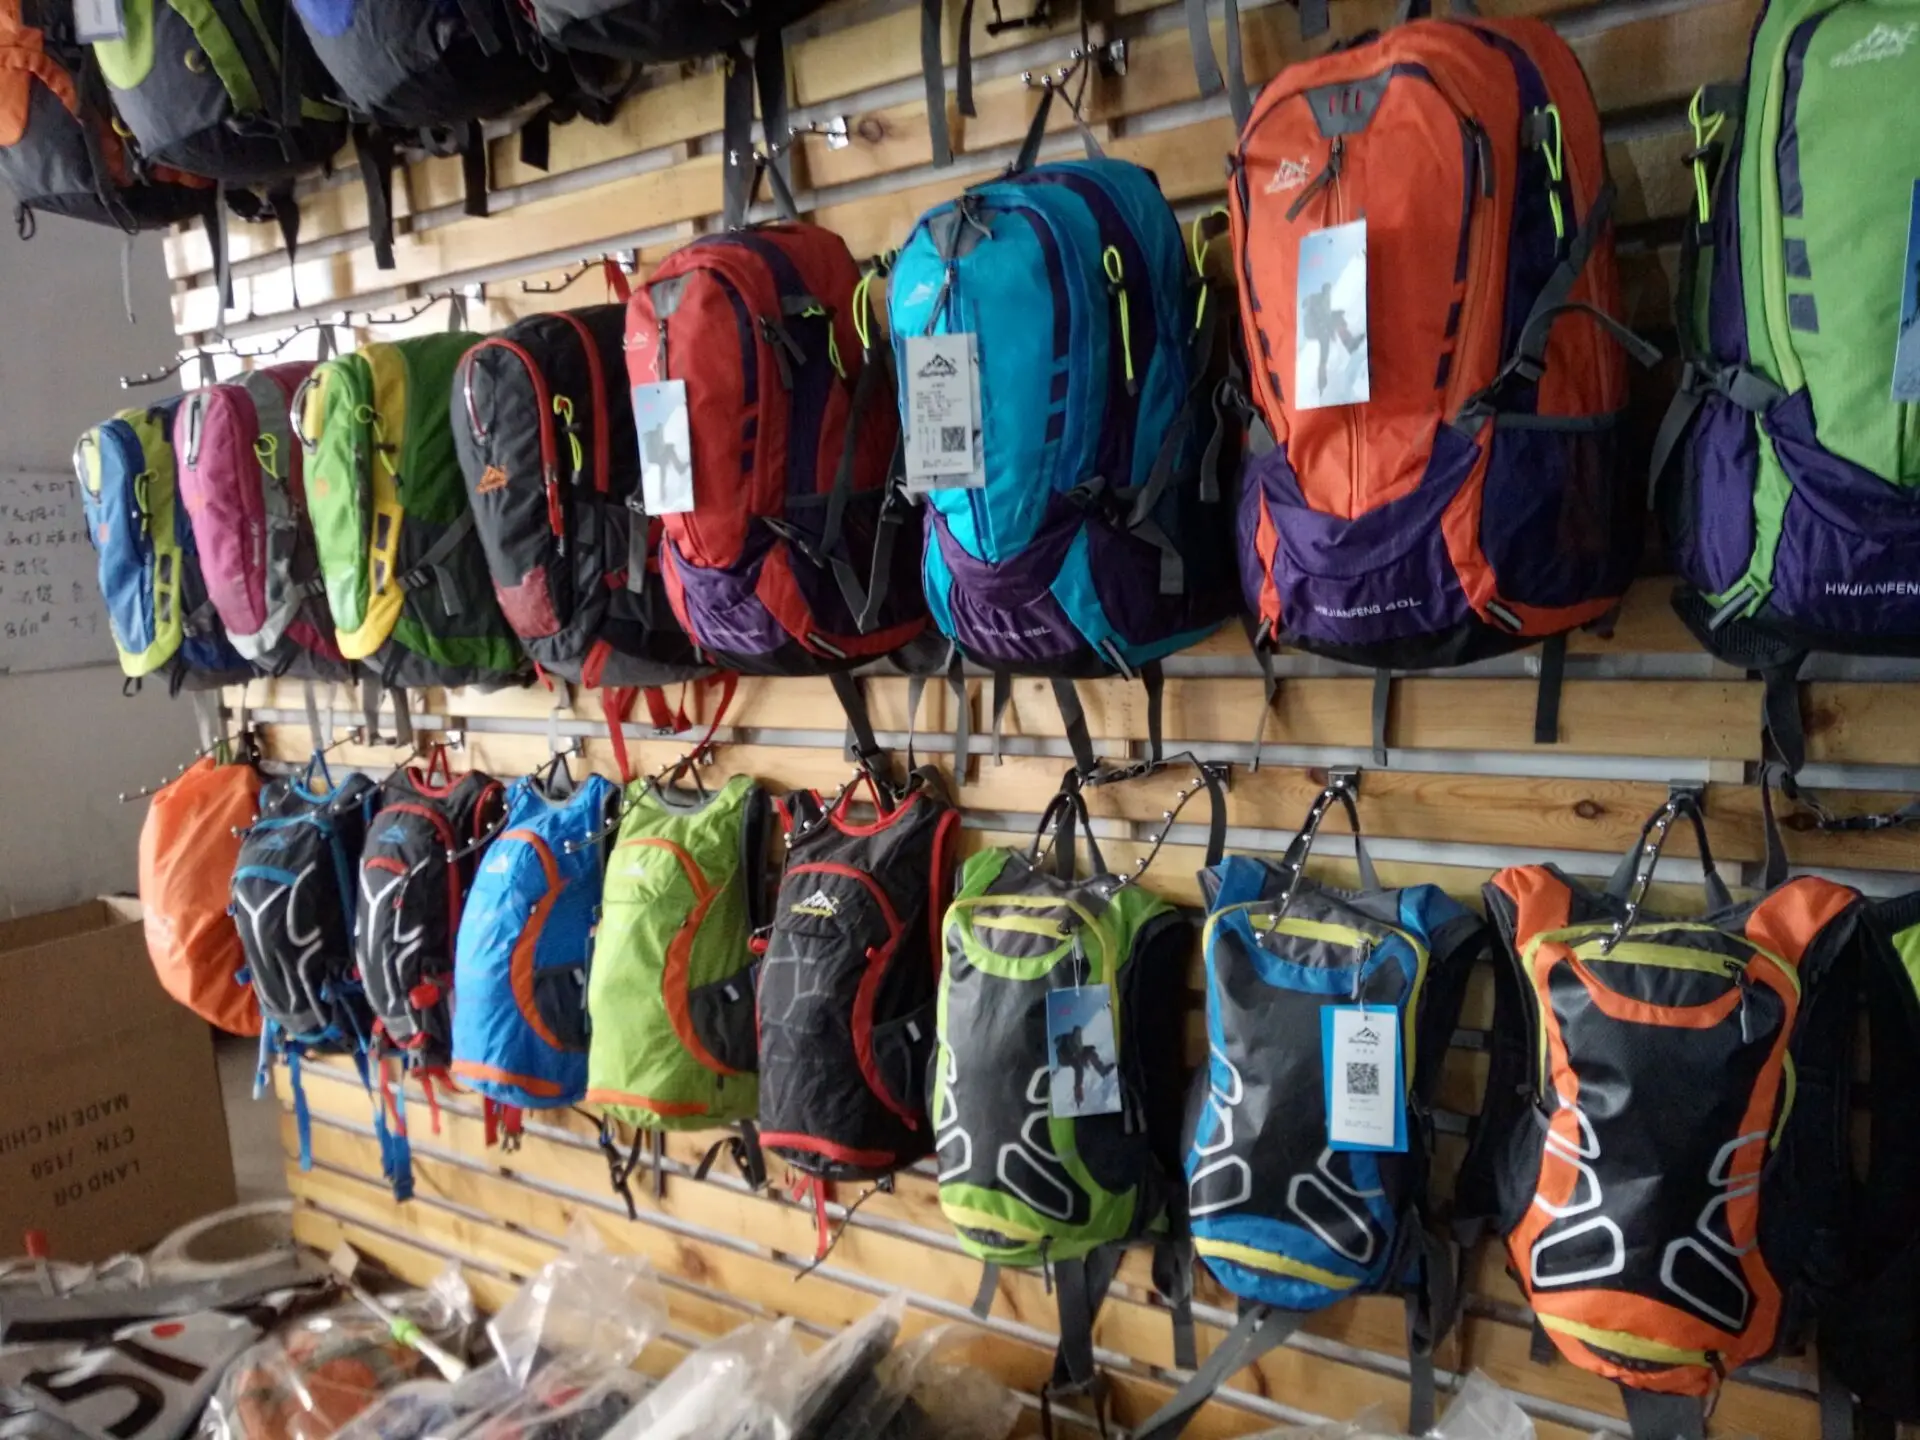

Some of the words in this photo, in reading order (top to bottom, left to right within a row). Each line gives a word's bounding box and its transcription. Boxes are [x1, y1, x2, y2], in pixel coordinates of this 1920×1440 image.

[1825, 581, 1920, 596] HWJIANFEN
[71, 1093, 129, 1127] MADE
[47, 1113, 68, 1137] IN
[88, 1159, 140, 1192] LAND
